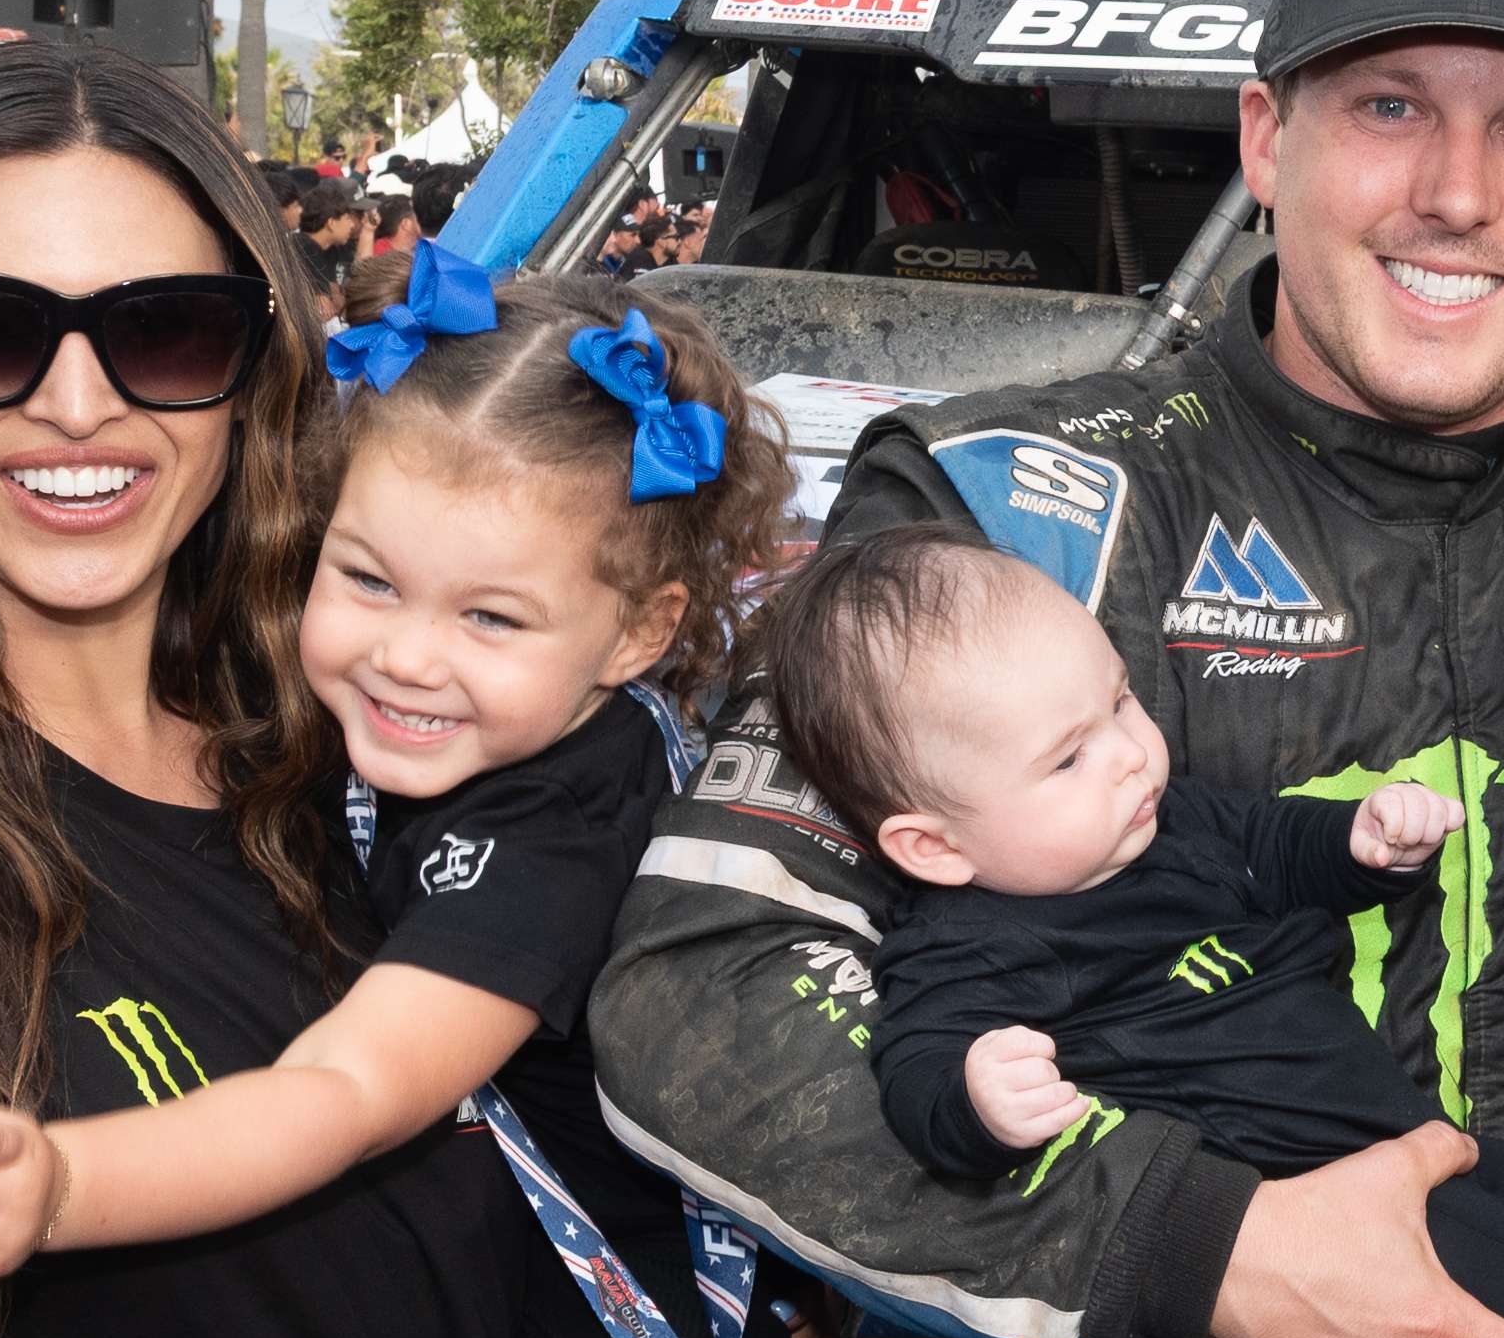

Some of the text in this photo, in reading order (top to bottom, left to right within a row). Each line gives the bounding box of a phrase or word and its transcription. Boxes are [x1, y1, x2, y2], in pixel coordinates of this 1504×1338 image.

[725, 3, 921, 21] INTERNATIONAL
[771, 12, 832, 22] ROAD
[840, 16, 927, 28] RACING
[892, 242, 1037, 272] COBRA
[894, 265, 1033, 284] TECHNOLOGY
[1007, 490, 1096, 534] SIMPSON
[1202, 651, 1307, 681] Racing
